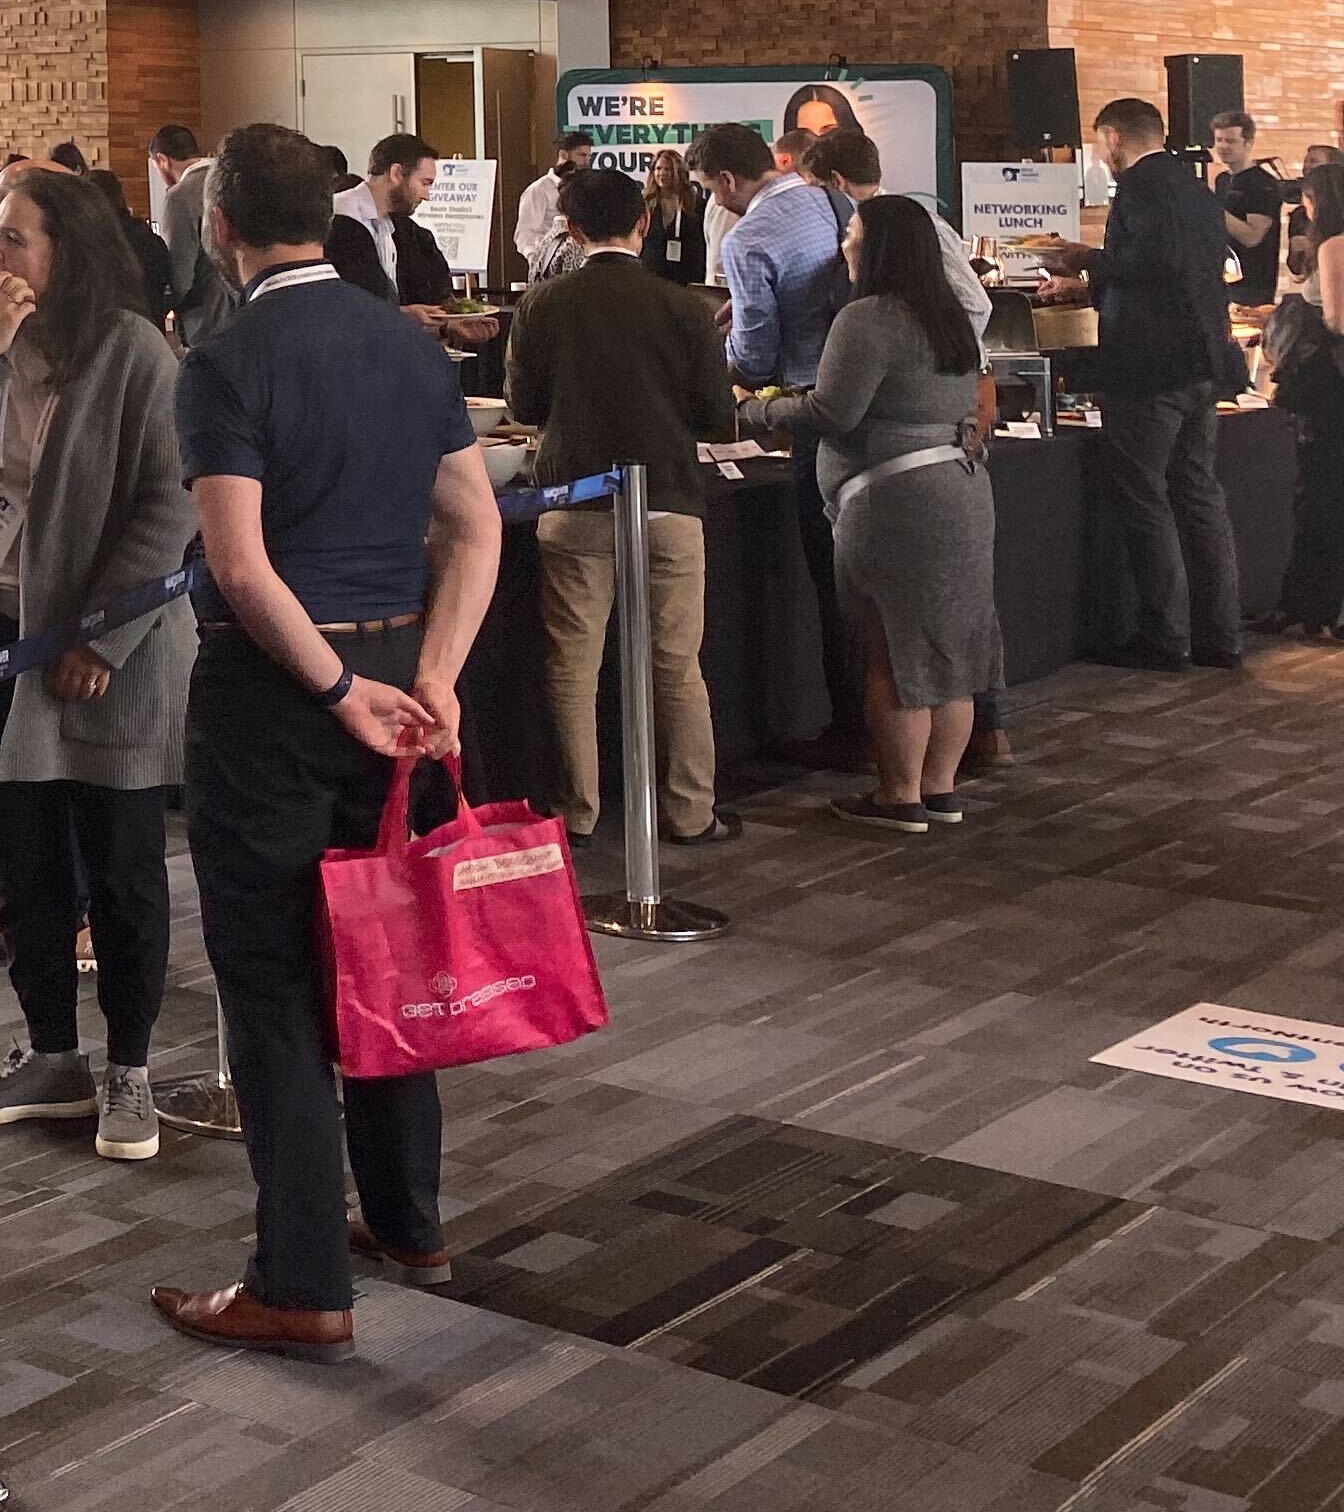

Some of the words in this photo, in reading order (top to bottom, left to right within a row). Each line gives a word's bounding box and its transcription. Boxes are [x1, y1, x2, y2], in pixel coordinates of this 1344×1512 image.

[459, 183, 477, 191] OUR
[974, 203, 1067, 215] NETWORKING
[998, 217, 1043, 229] LUNCH
[1172, 1061, 1218, 1074] on
